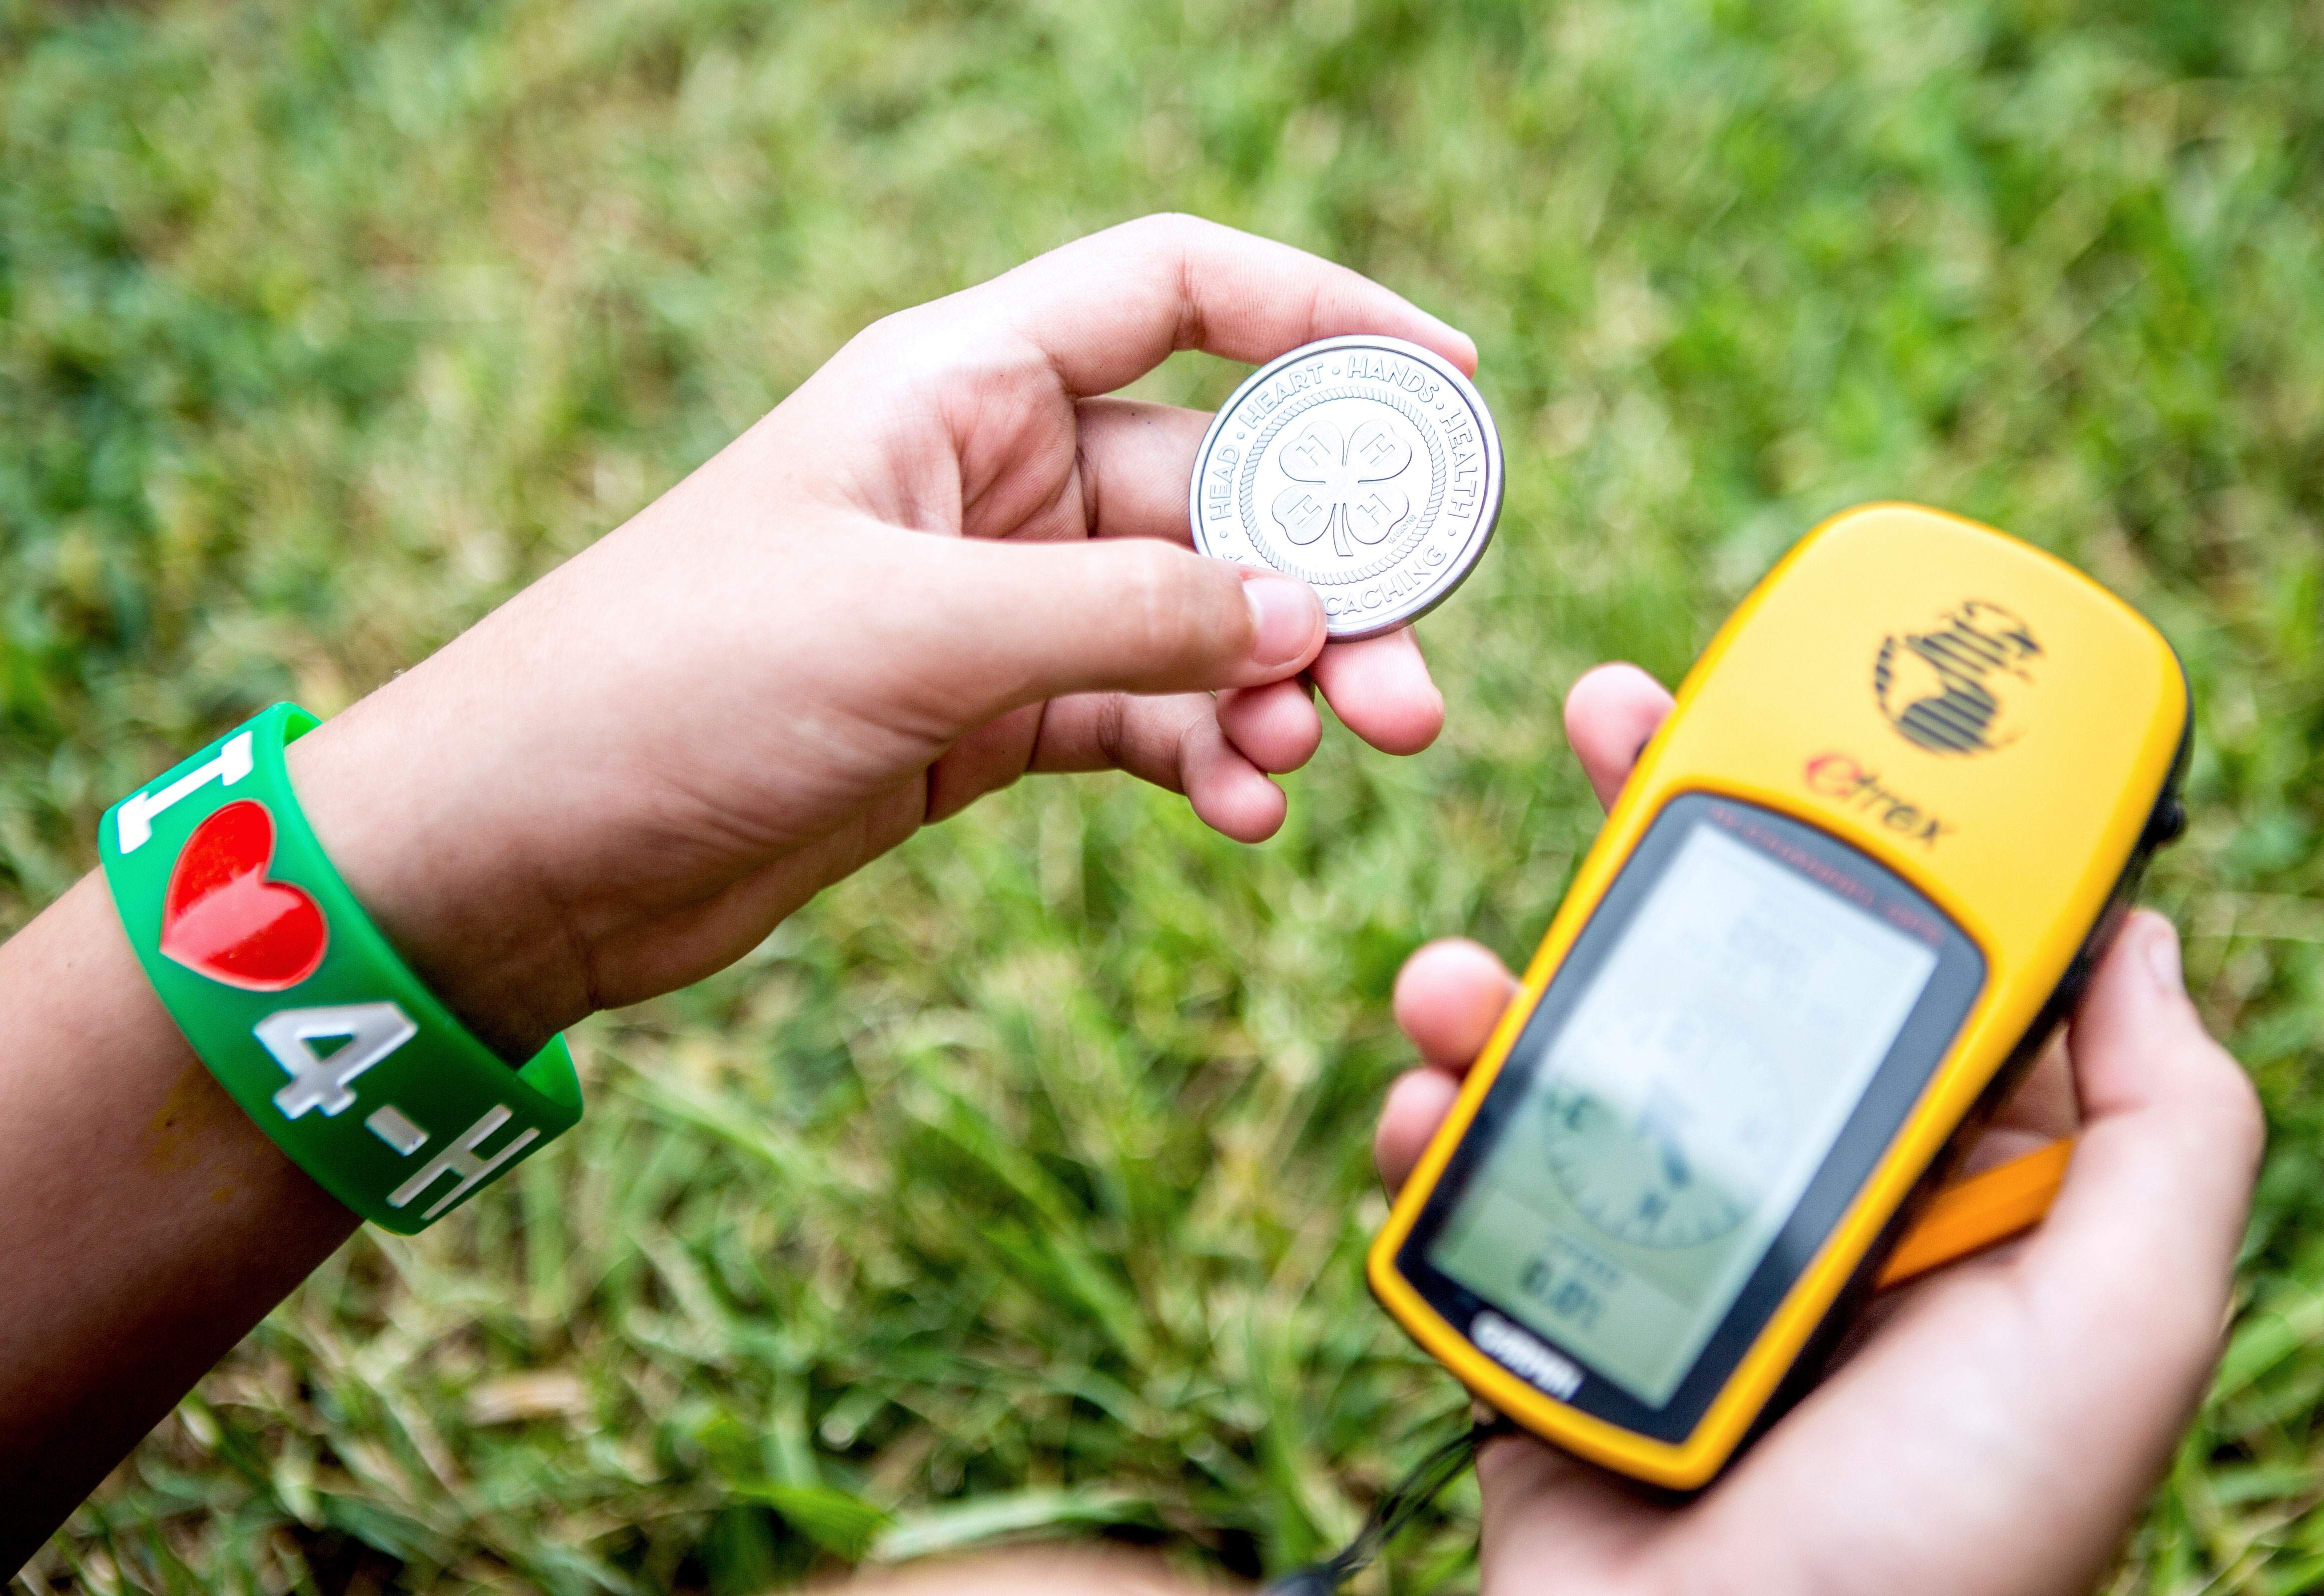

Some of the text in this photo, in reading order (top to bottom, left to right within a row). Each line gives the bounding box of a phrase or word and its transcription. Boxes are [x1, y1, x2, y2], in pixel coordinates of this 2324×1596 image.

[1210, 356, 1478, 521] HEAD HEART HANDS HEALTH
[1296, 434, 1330, 467] H
[1360, 432, 1395, 467] H
[1287, 494, 1322, 528] H
[1356, 493, 1391, 528] H
[1322, 545, 1447, 616] CACHING
[116, 730, 543, 1221] I 4-H
